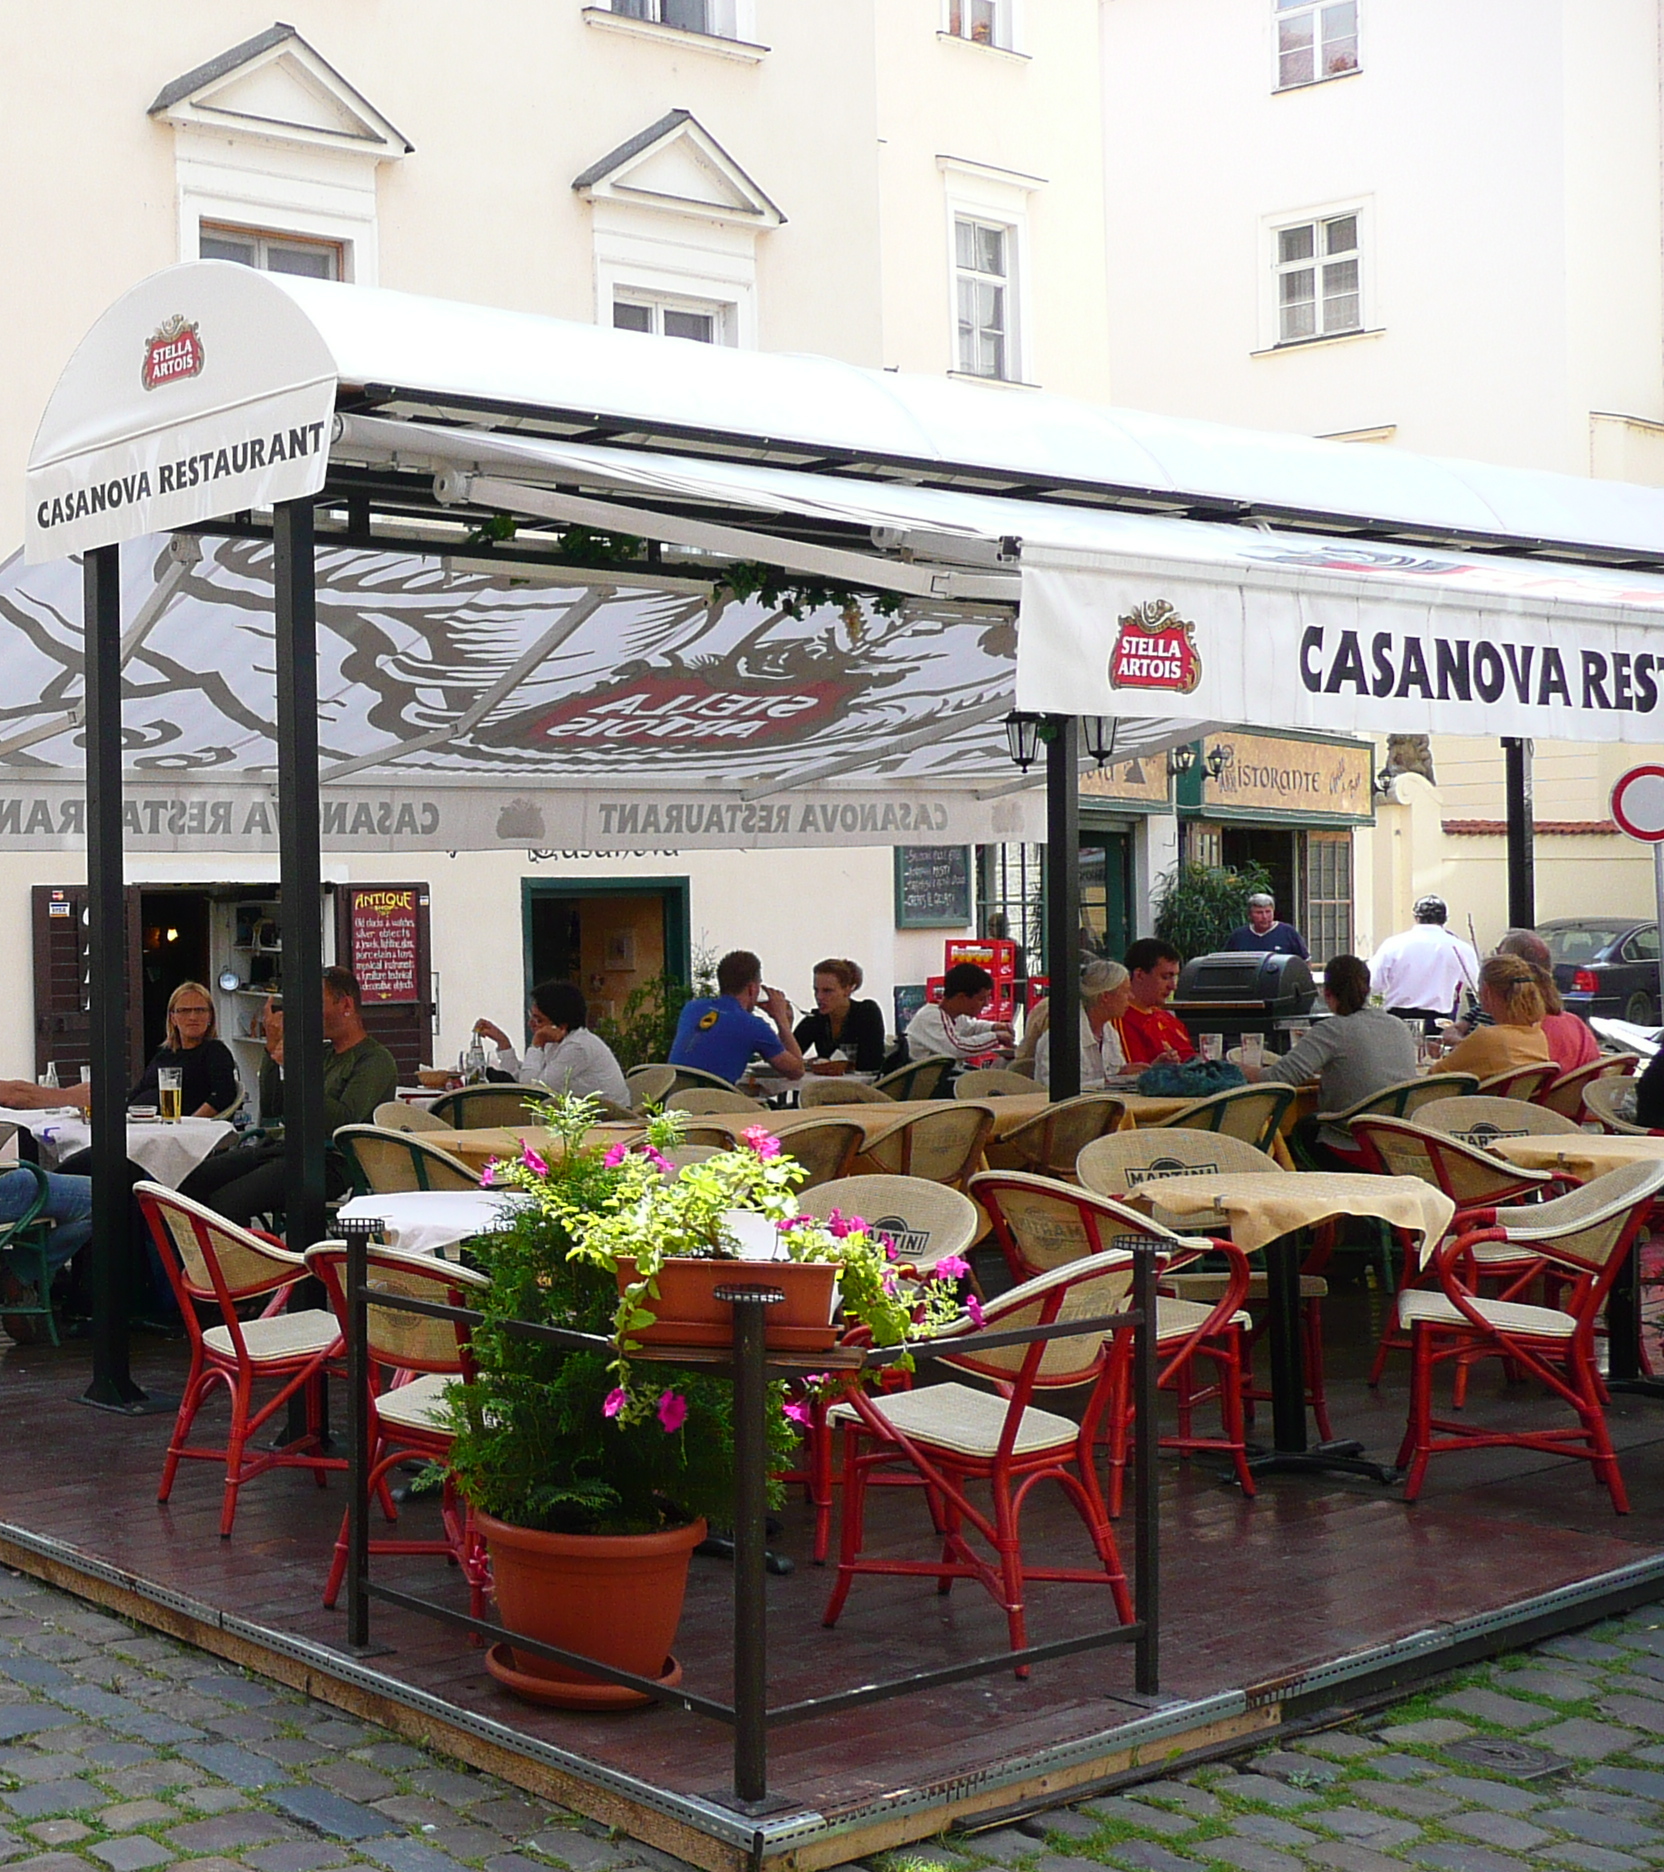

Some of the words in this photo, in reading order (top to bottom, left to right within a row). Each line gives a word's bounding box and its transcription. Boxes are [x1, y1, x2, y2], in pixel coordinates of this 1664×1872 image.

[152, 338, 193, 364] STELLA
[152, 354, 194, 379] ARTOIS
[37, 471, 152, 529] CASANOVA
[158, 421, 325, 495] RESTAURANT
[1120, 635, 1181, 659] STELLA
[1116, 657, 1182, 680] ARTOIS
[1299, 626, 1572, 707] CASANOVA
[1579, 650, 1664, 714] RES
[355, 892, 412, 910] ANTIQUE
